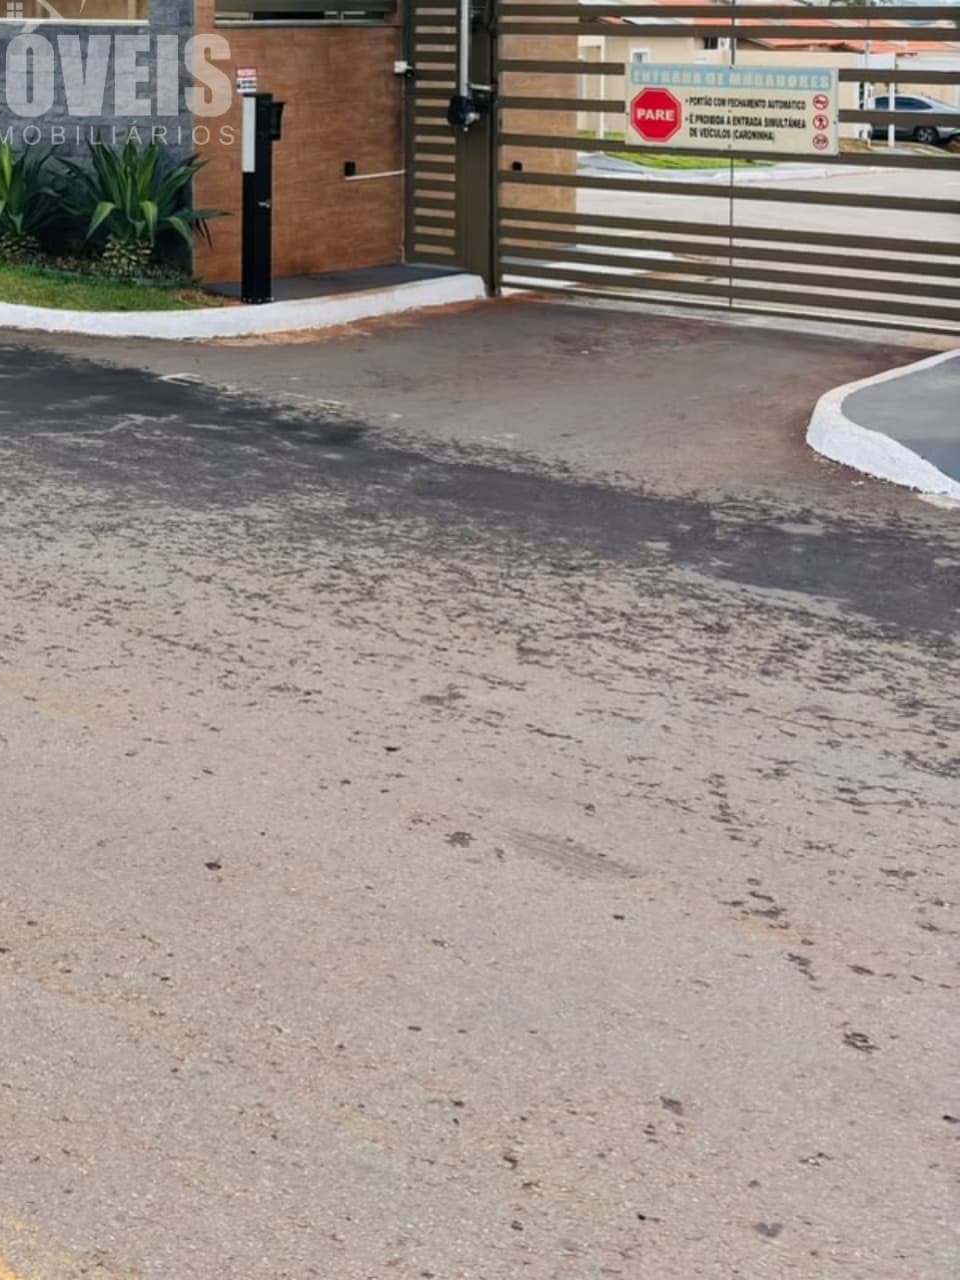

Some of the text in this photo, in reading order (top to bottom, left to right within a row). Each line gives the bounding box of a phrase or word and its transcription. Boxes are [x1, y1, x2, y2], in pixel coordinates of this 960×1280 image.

[632, 69, 702, 85] ENTRADA
[705, 71, 724, 85] DE
[636, 107, 675, 122] PARE
[732, 115, 762, 127] ENTRADA
